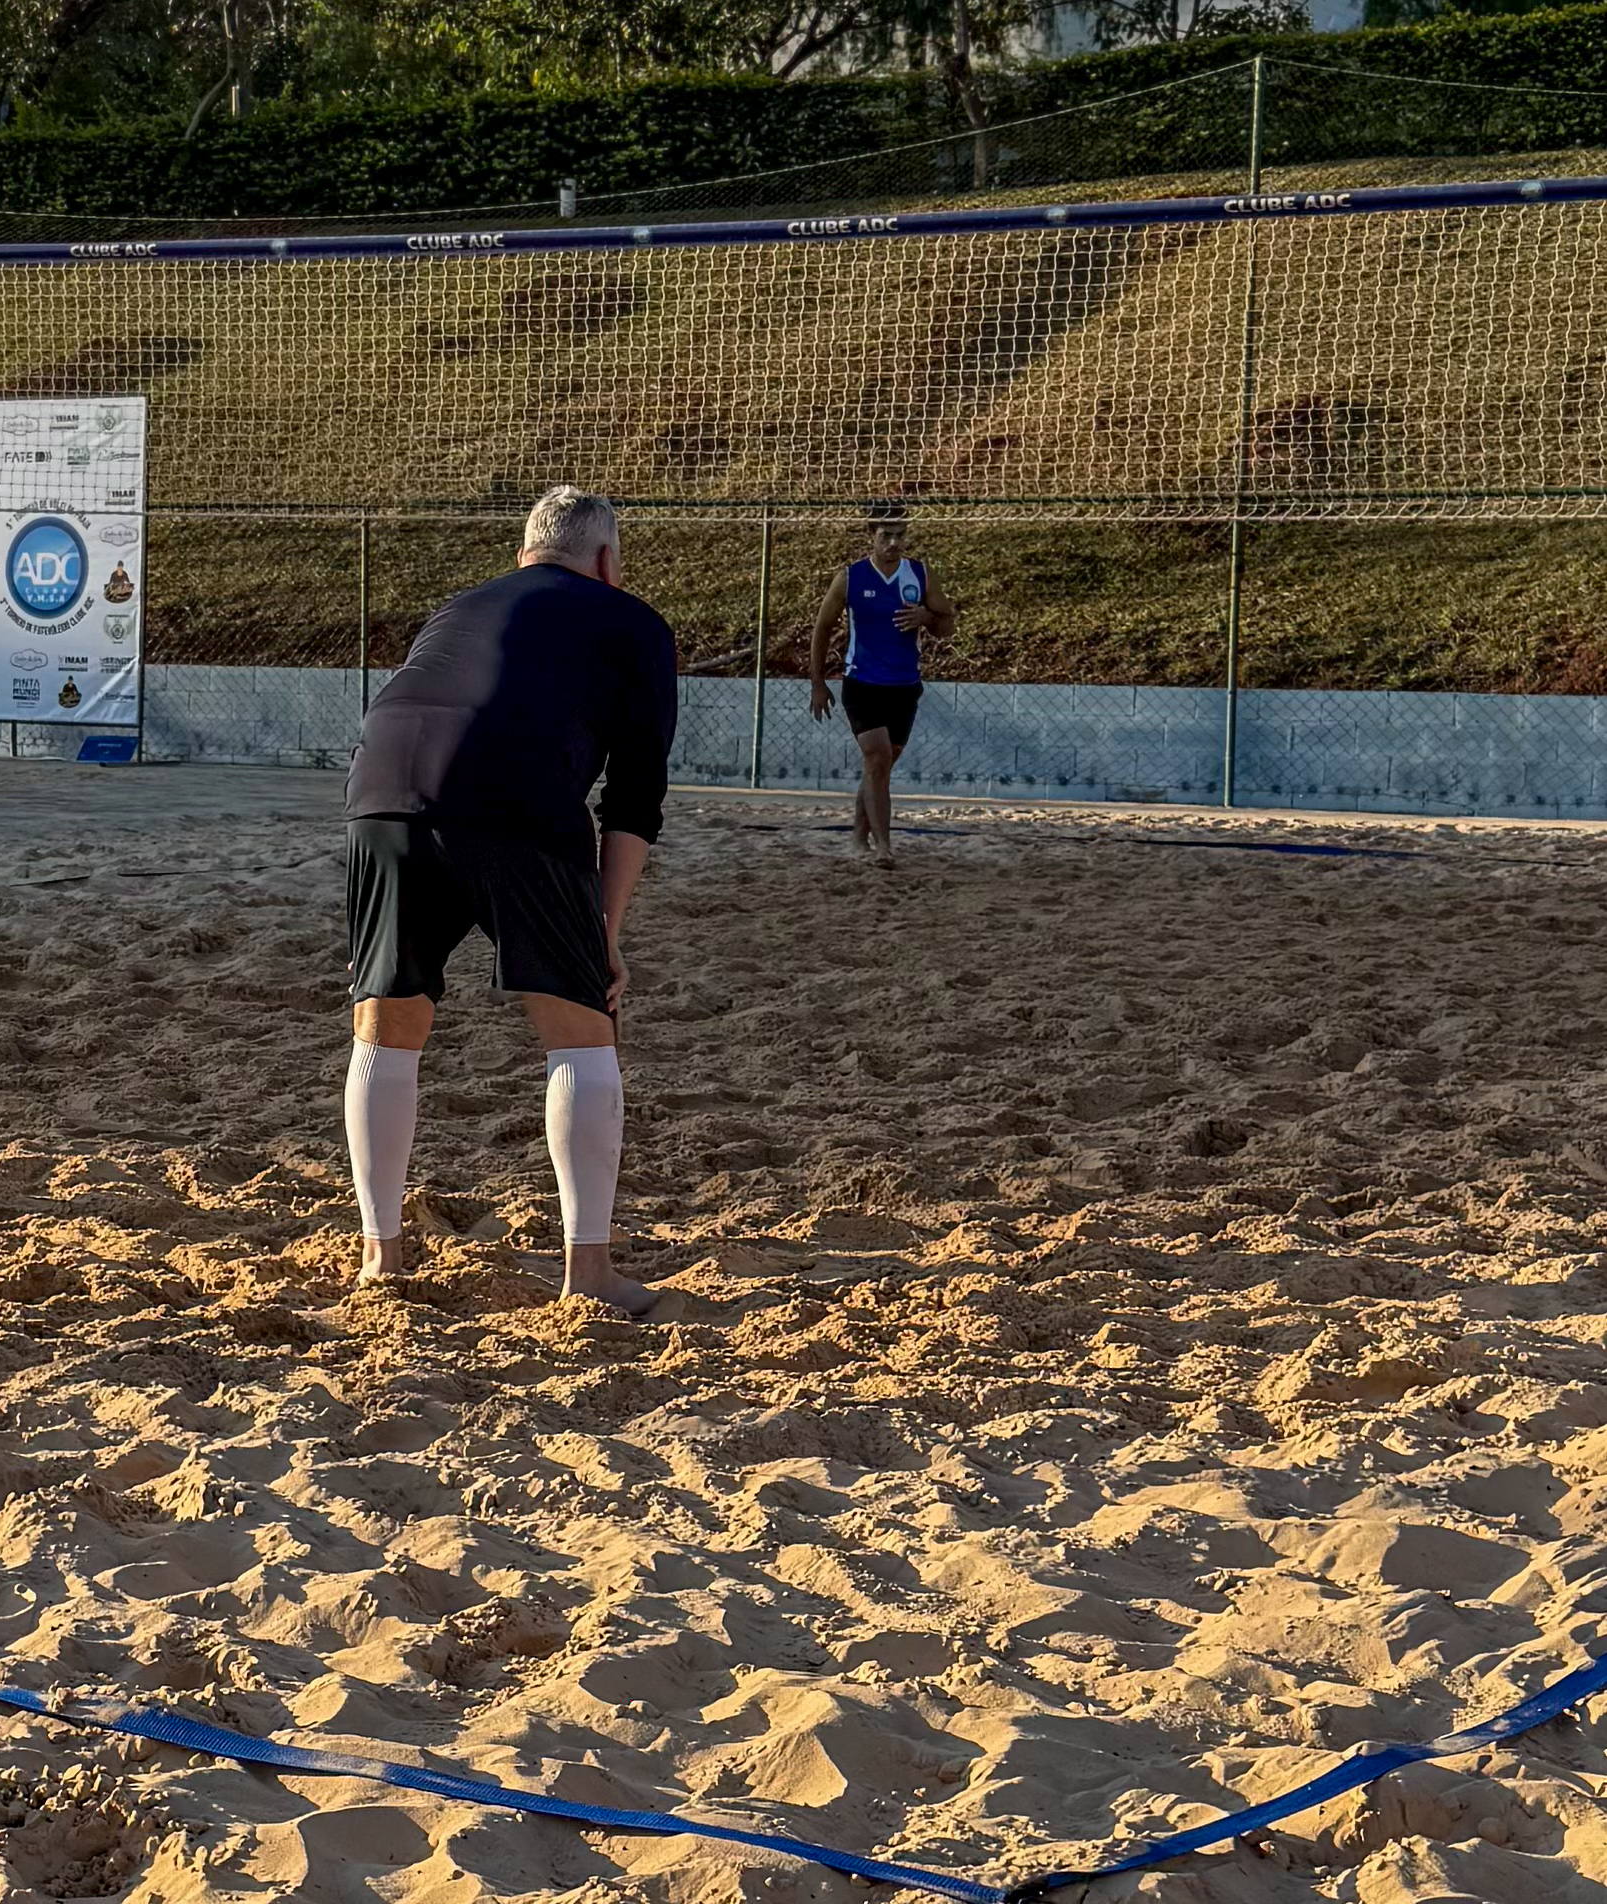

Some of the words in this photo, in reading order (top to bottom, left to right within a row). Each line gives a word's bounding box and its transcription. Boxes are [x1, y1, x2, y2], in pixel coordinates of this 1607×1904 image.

[1223, 196, 1298, 213] CLUBE
[1304, 193, 1352, 210] ADC
[787, 219, 852, 236] CLUBE
[857, 217, 899, 233] ADC
[70, 244, 121, 257] CLUBE
[125, 243, 159, 256] ADC
[406, 235, 463, 250] CLUBE
[469, 233, 505, 248] ADC
[14, 552, 81, 586] ADC
